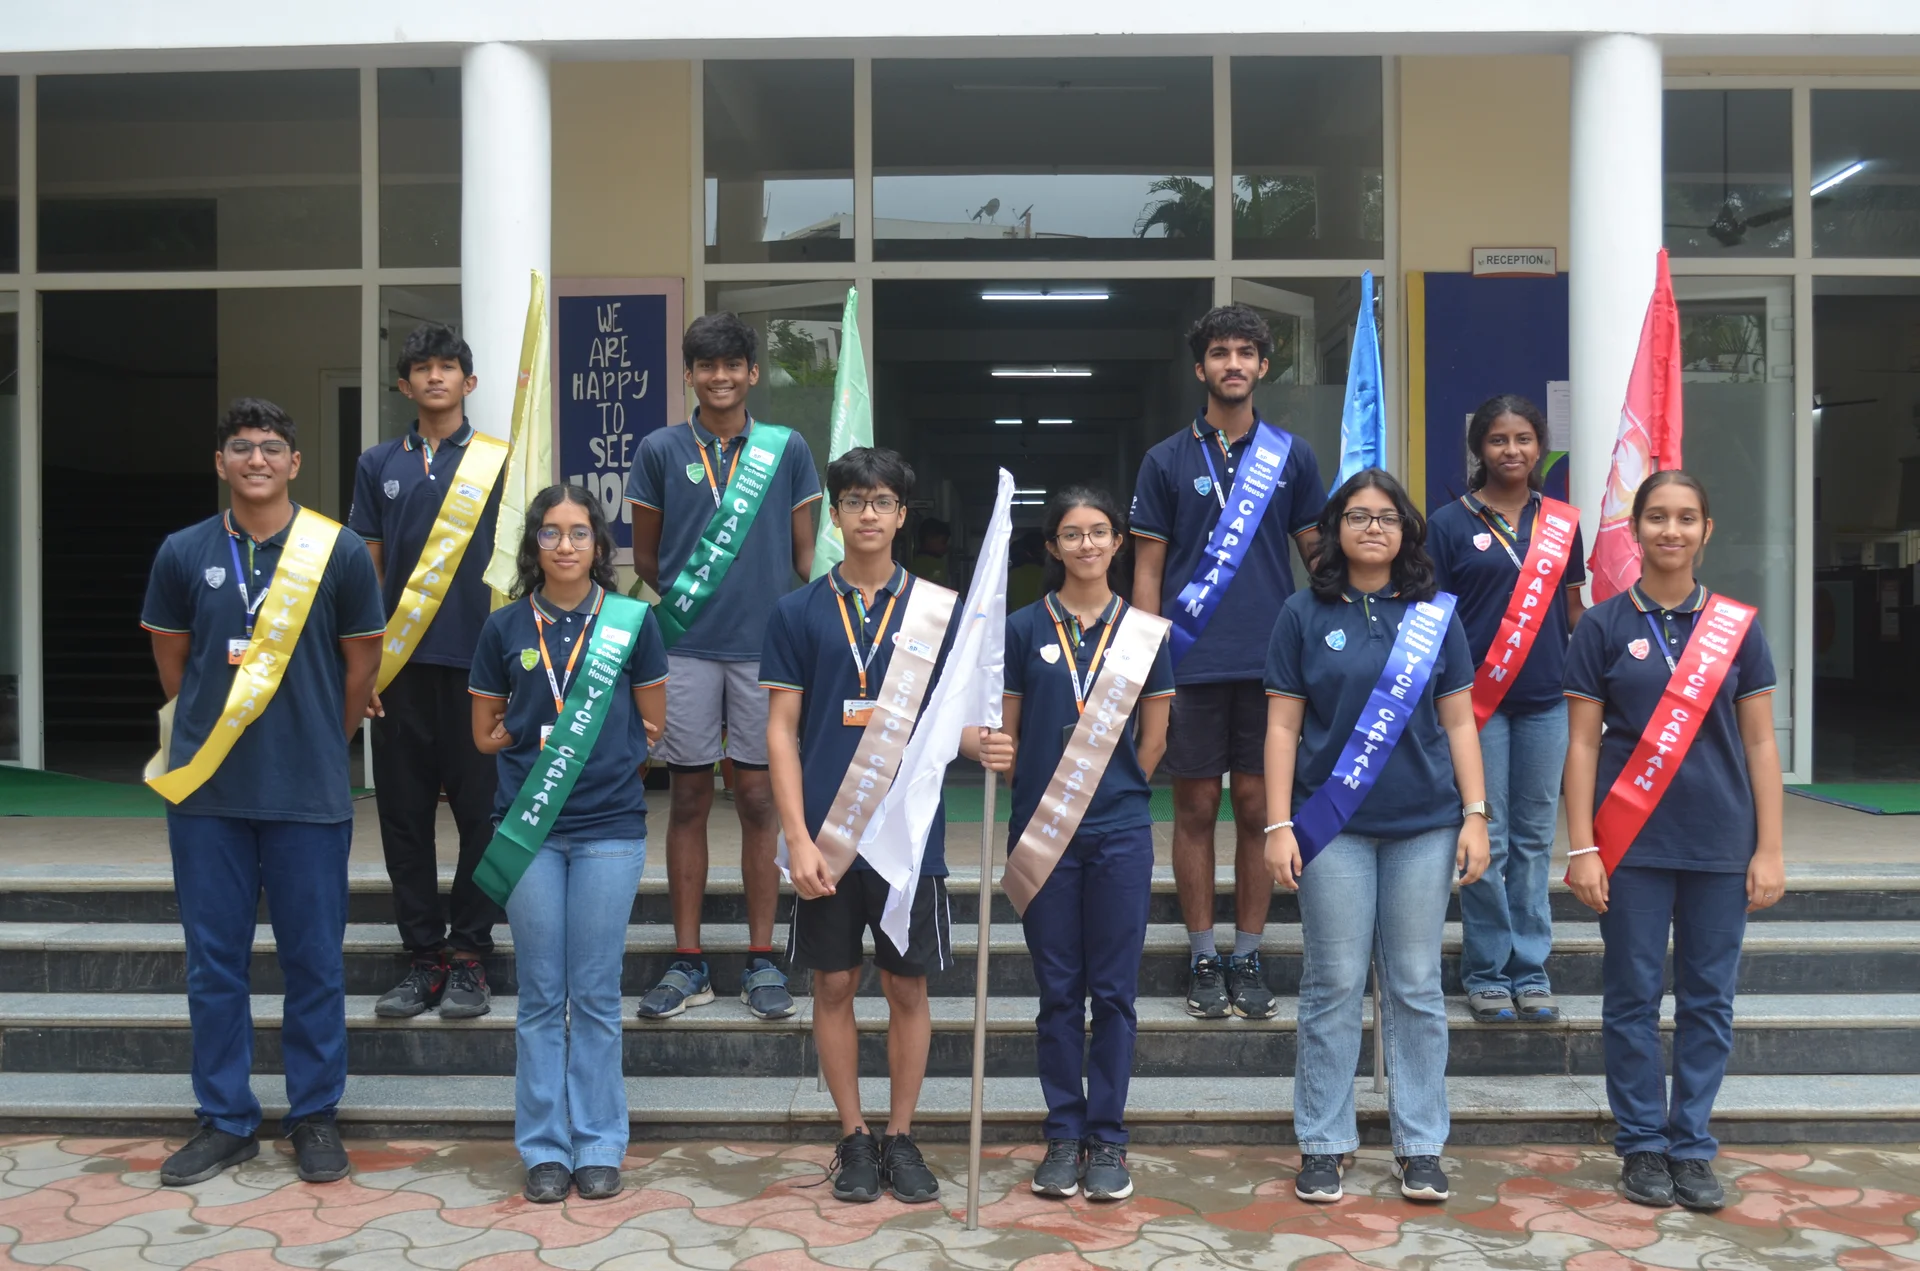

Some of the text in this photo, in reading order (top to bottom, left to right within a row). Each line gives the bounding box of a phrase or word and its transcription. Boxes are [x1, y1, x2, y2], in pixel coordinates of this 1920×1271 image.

[1486, 255, 1543, 265] RECEPTION
[597, 303, 623, 333] WE
[589, 335, 631, 368] ARE
[572, 370, 649, 401] HAPPY
[596, 402, 624, 434] TO
[589, 433, 633, 468] SEE
[743, 465, 767, 480] School
[1249, 466, 1273, 481] School
[1255, 462, 1272, 474] High
[736, 482, 759, 498] House
[738, 474, 763, 491] Prithvi
[1242, 483, 1265, 499] House
[1245, 475, 1269, 491] Amber
[674, 497, 748, 613] CAPTAIN
[1185, 499, 1255, 618] CAPTAIN
[388, 537, 456, 656] CAPTAIN
[1488, 558, 1553, 683] CAPTAIN
[1707, 620, 1737, 636] School
[1714, 616, 1735, 628] High
[602, 643, 621, 655] High
[1698, 636, 1728, 655] House
[1706, 632, 1729, 645] Agni
[226, 594, 300, 729] VICE CAPTAIN
[596, 648, 622, 664] School
[588, 668, 614, 687] House
[591, 659, 618, 678] Prithvi
[879, 669, 918, 744] SCHOOL
[1342, 651, 1423, 790] VICE CAPTAIN
[1633, 651, 1718, 792] VICE CAPTAIN
[520, 685, 604, 827] VICE CAPTAIN
[1042, 675, 1128, 840] SCHOOL CAPTAIN
[836, 754, 885, 840] CAPTAIN
